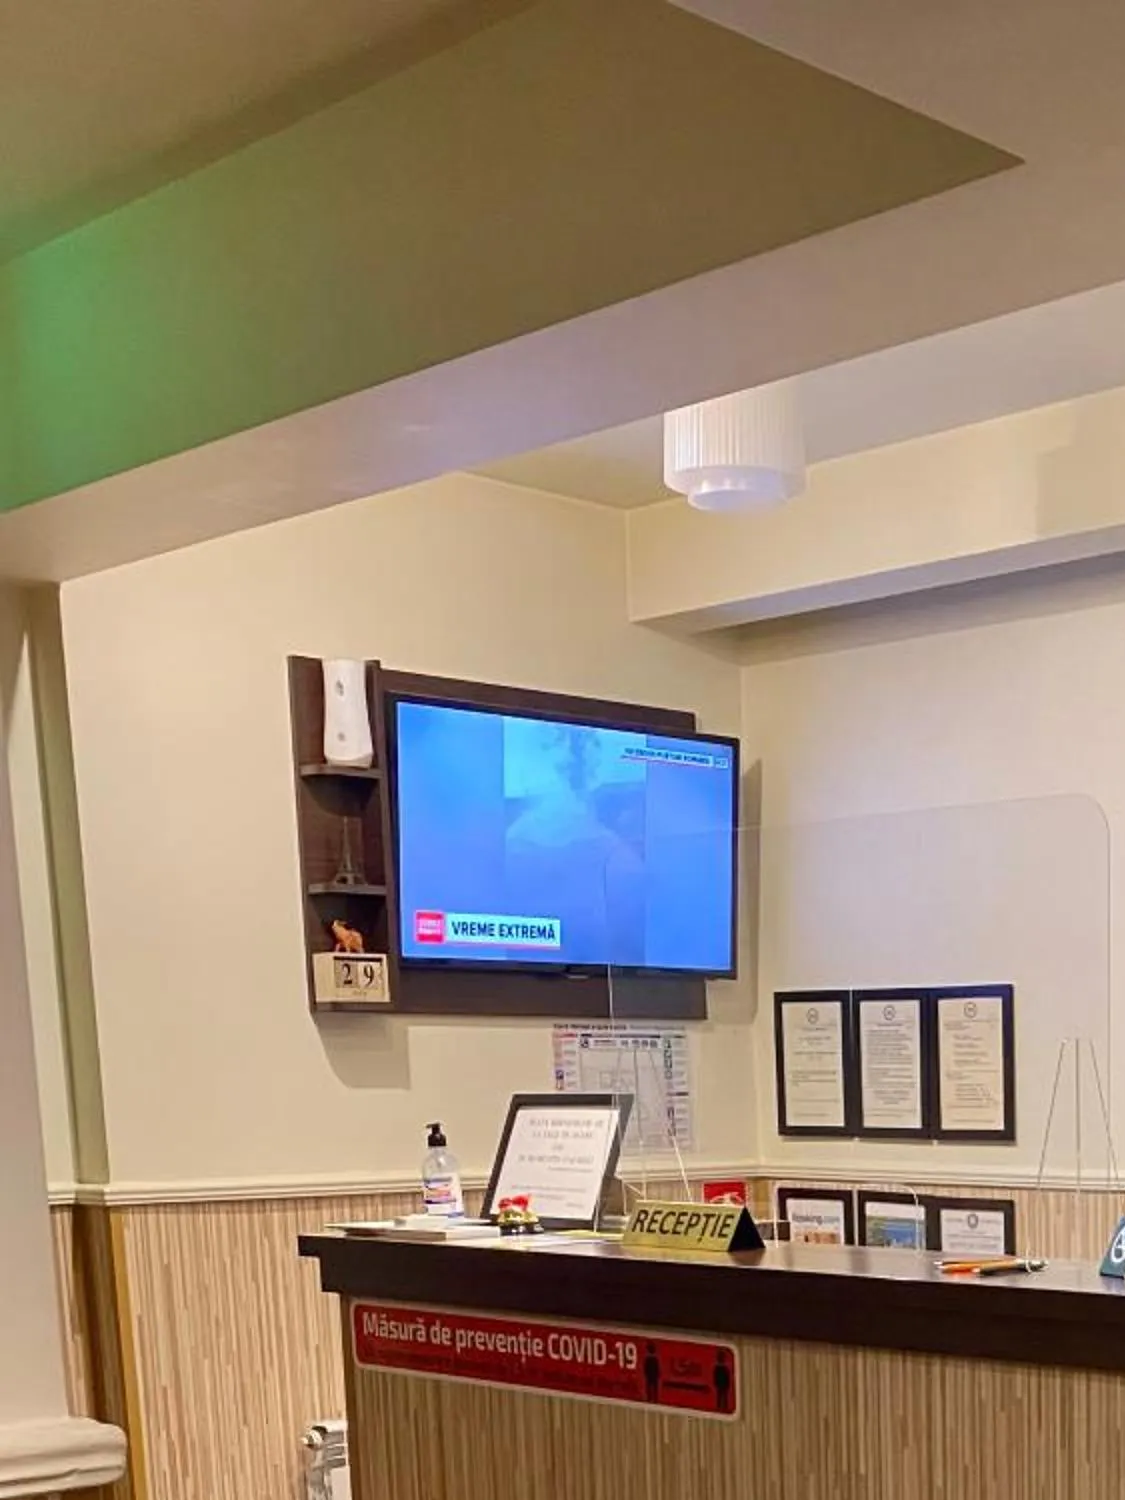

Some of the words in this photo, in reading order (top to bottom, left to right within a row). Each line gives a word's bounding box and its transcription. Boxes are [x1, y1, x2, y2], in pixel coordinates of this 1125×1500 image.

[451, 921, 495, 937] VREME
[429, 1319, 451, 1346] de
[548, 1333, 638, 1369] COVID-19
